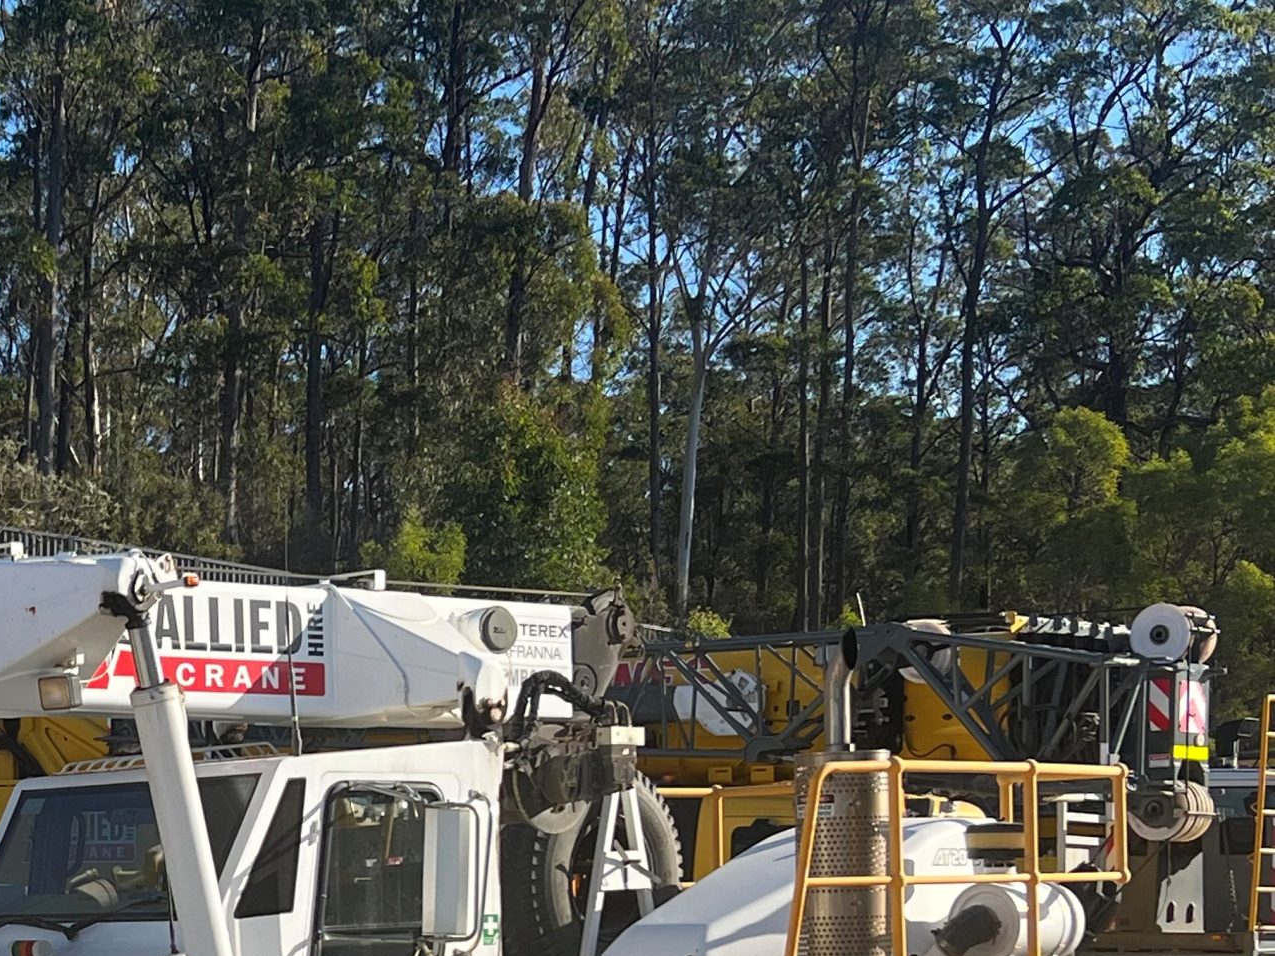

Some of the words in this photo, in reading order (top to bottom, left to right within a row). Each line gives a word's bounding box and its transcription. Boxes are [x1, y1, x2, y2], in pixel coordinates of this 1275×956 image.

[155, 595, 302, 655] ALLIED
[307, 602, 324, 657] HIRE
[519, 623, 568, 639] TEREX
[176, 663, 307, 690] CRANE
[933, 848, 968, 867] AT20
